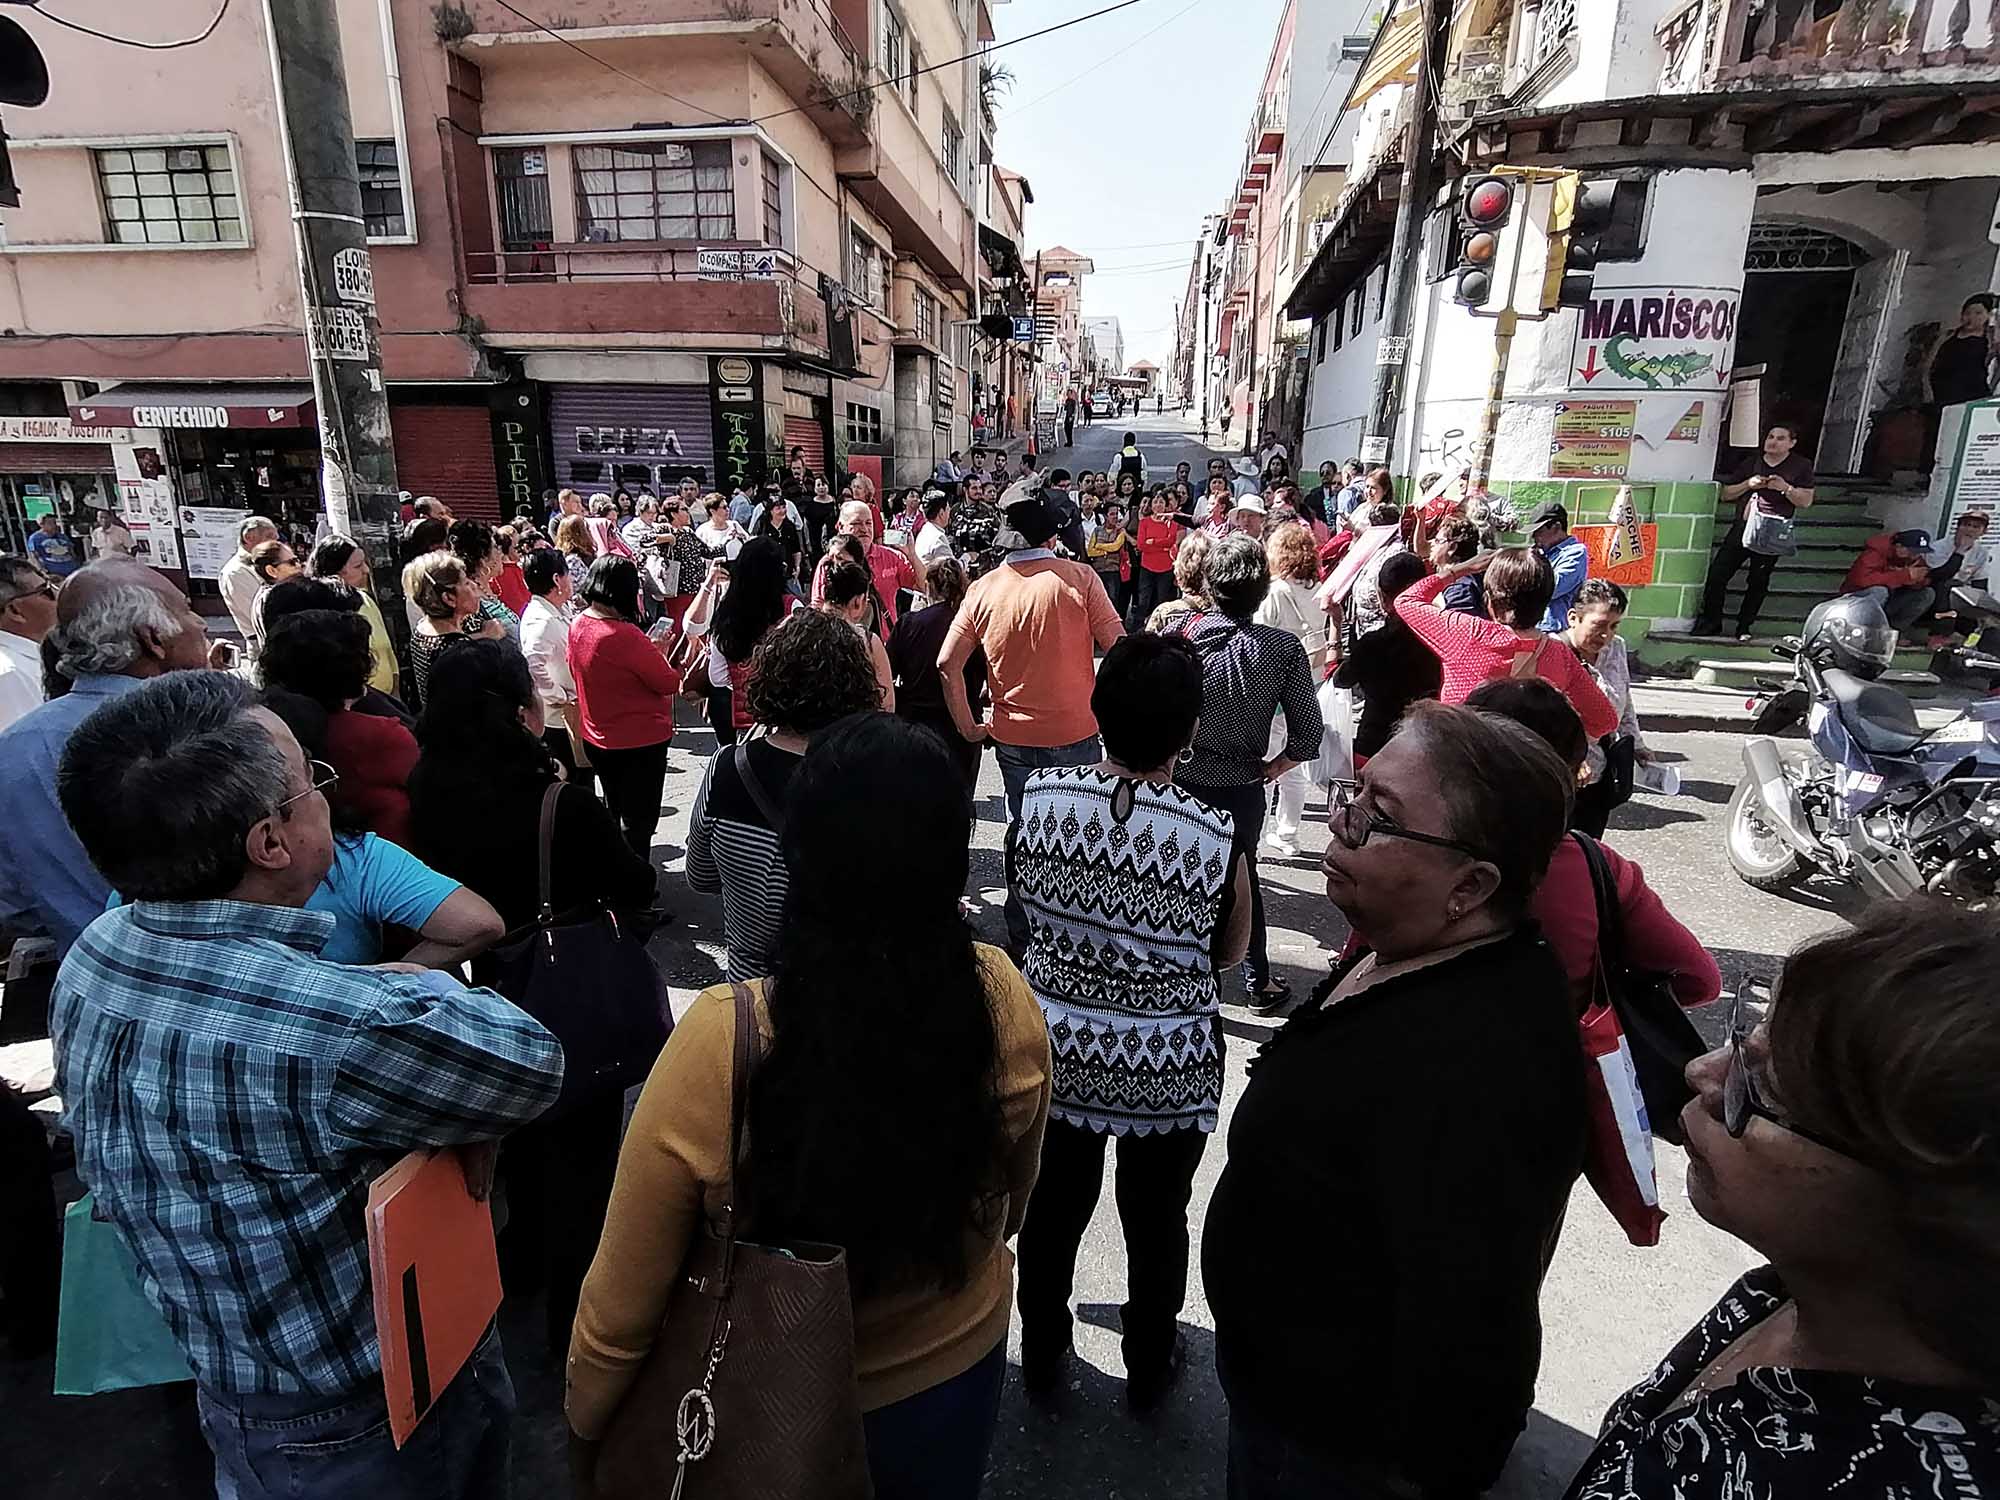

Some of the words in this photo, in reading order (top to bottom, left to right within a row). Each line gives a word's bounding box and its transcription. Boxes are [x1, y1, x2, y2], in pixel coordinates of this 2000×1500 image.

[1555, 403, 1564, 414] 2
[132, 406, 229, 428] CERVECHIDO
[23, 421, 58, 437] REGALOS
[1550, 444, 1559, 454] 3
